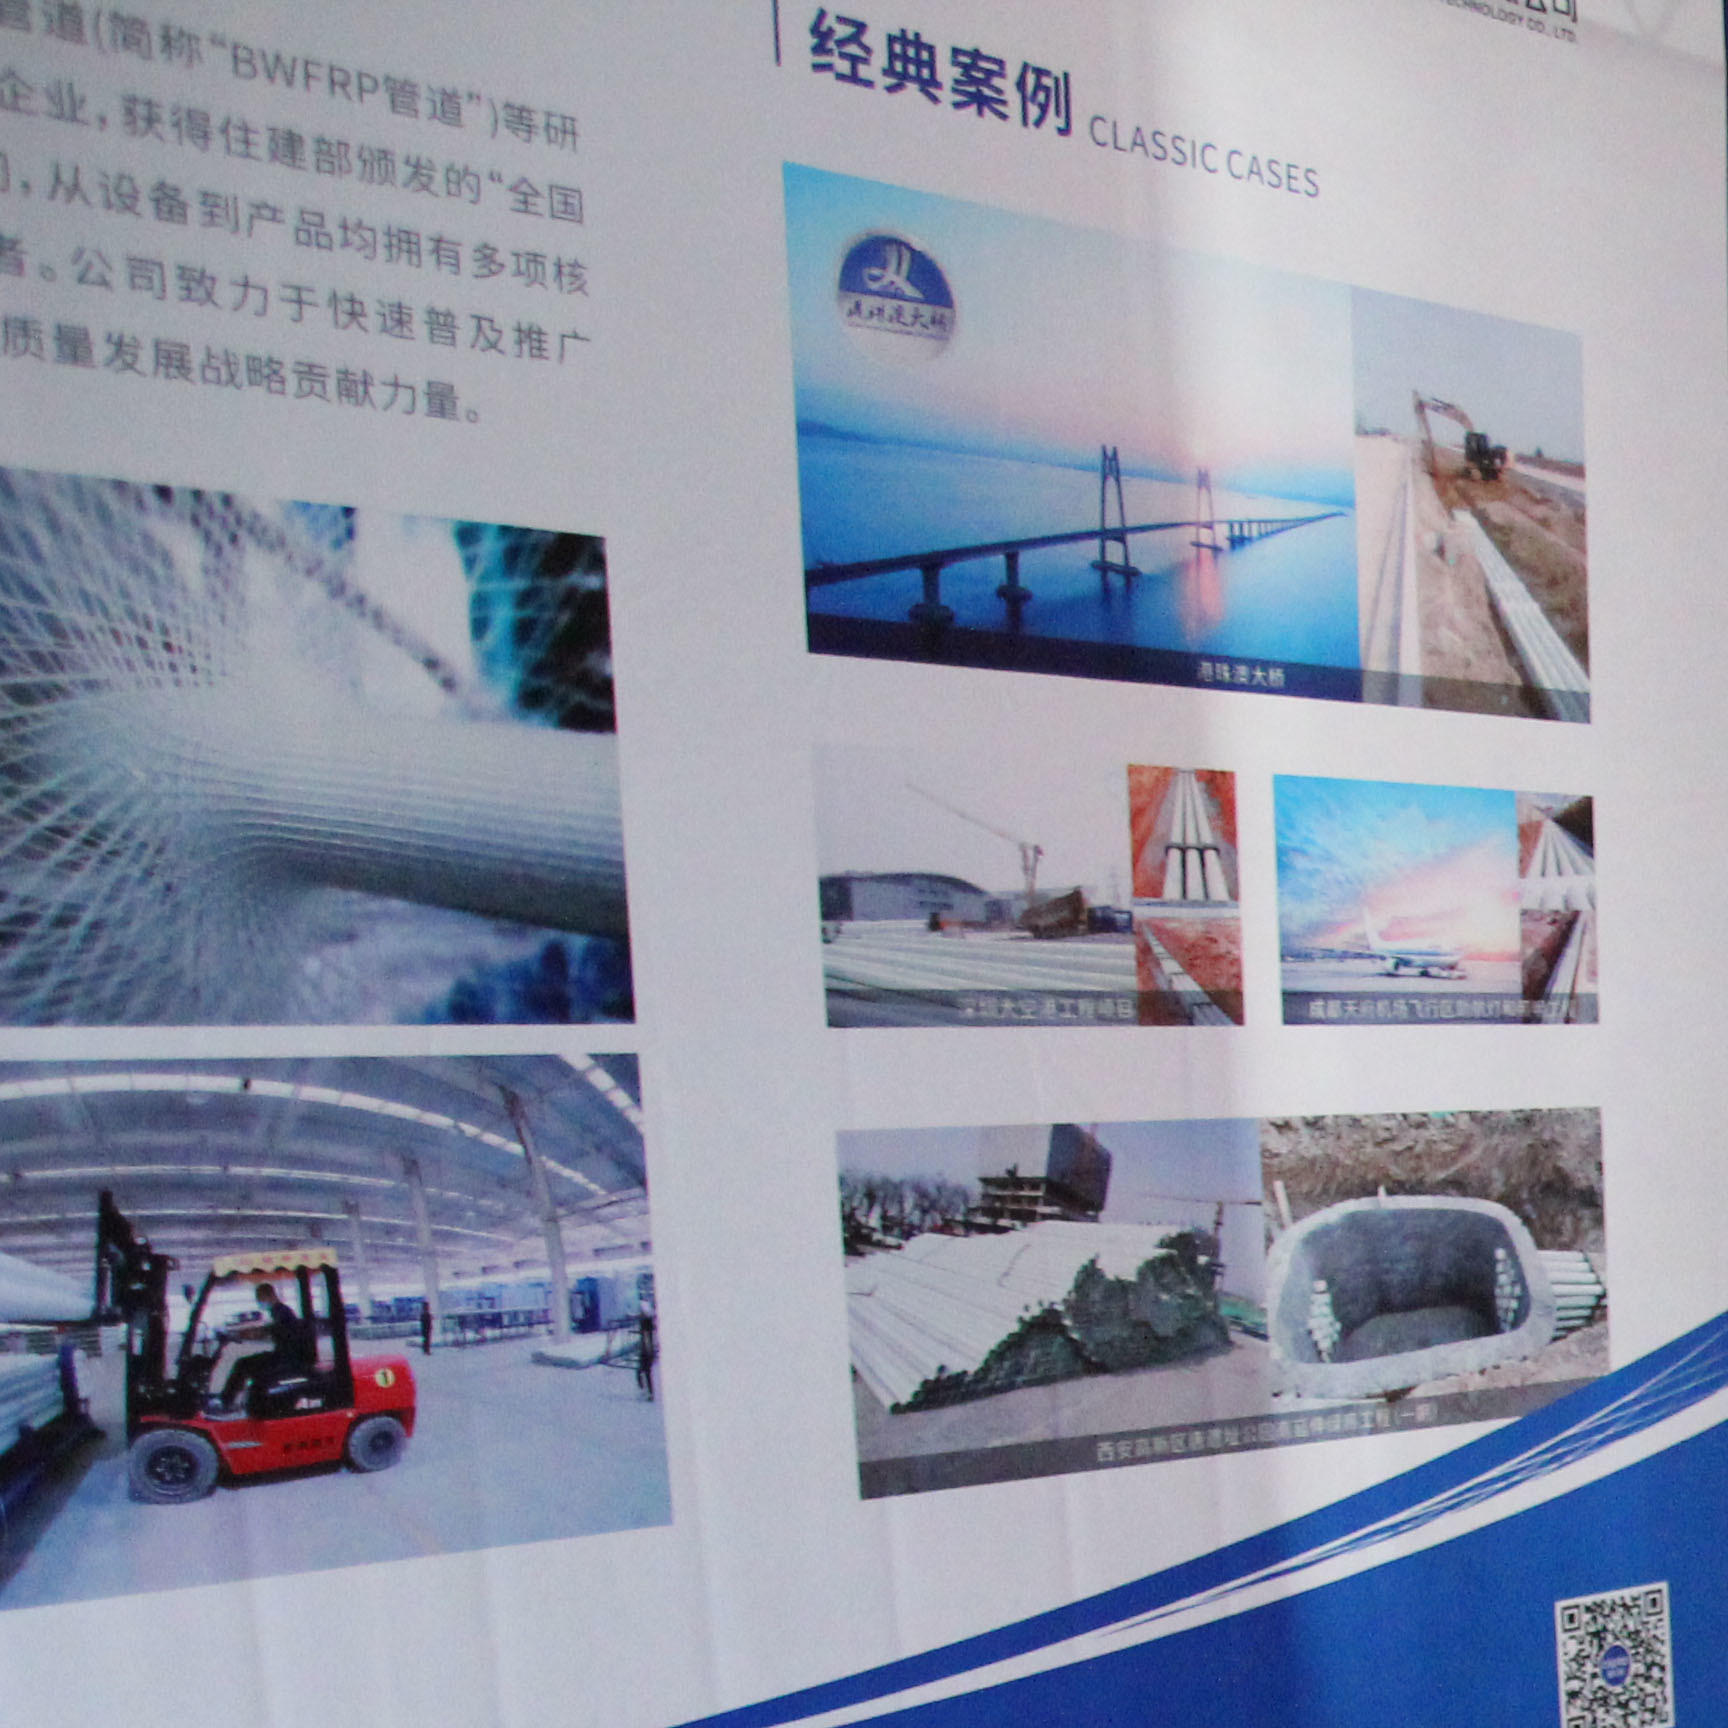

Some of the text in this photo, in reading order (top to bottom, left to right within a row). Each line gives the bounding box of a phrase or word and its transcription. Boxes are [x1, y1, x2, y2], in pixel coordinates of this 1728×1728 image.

[809, 8, 1072, 139] 经典案例
[1089, 114, 1321, 198] CLASSIC CASES
[2, 314, 481, 425] 质量发展战略贡献力量。
